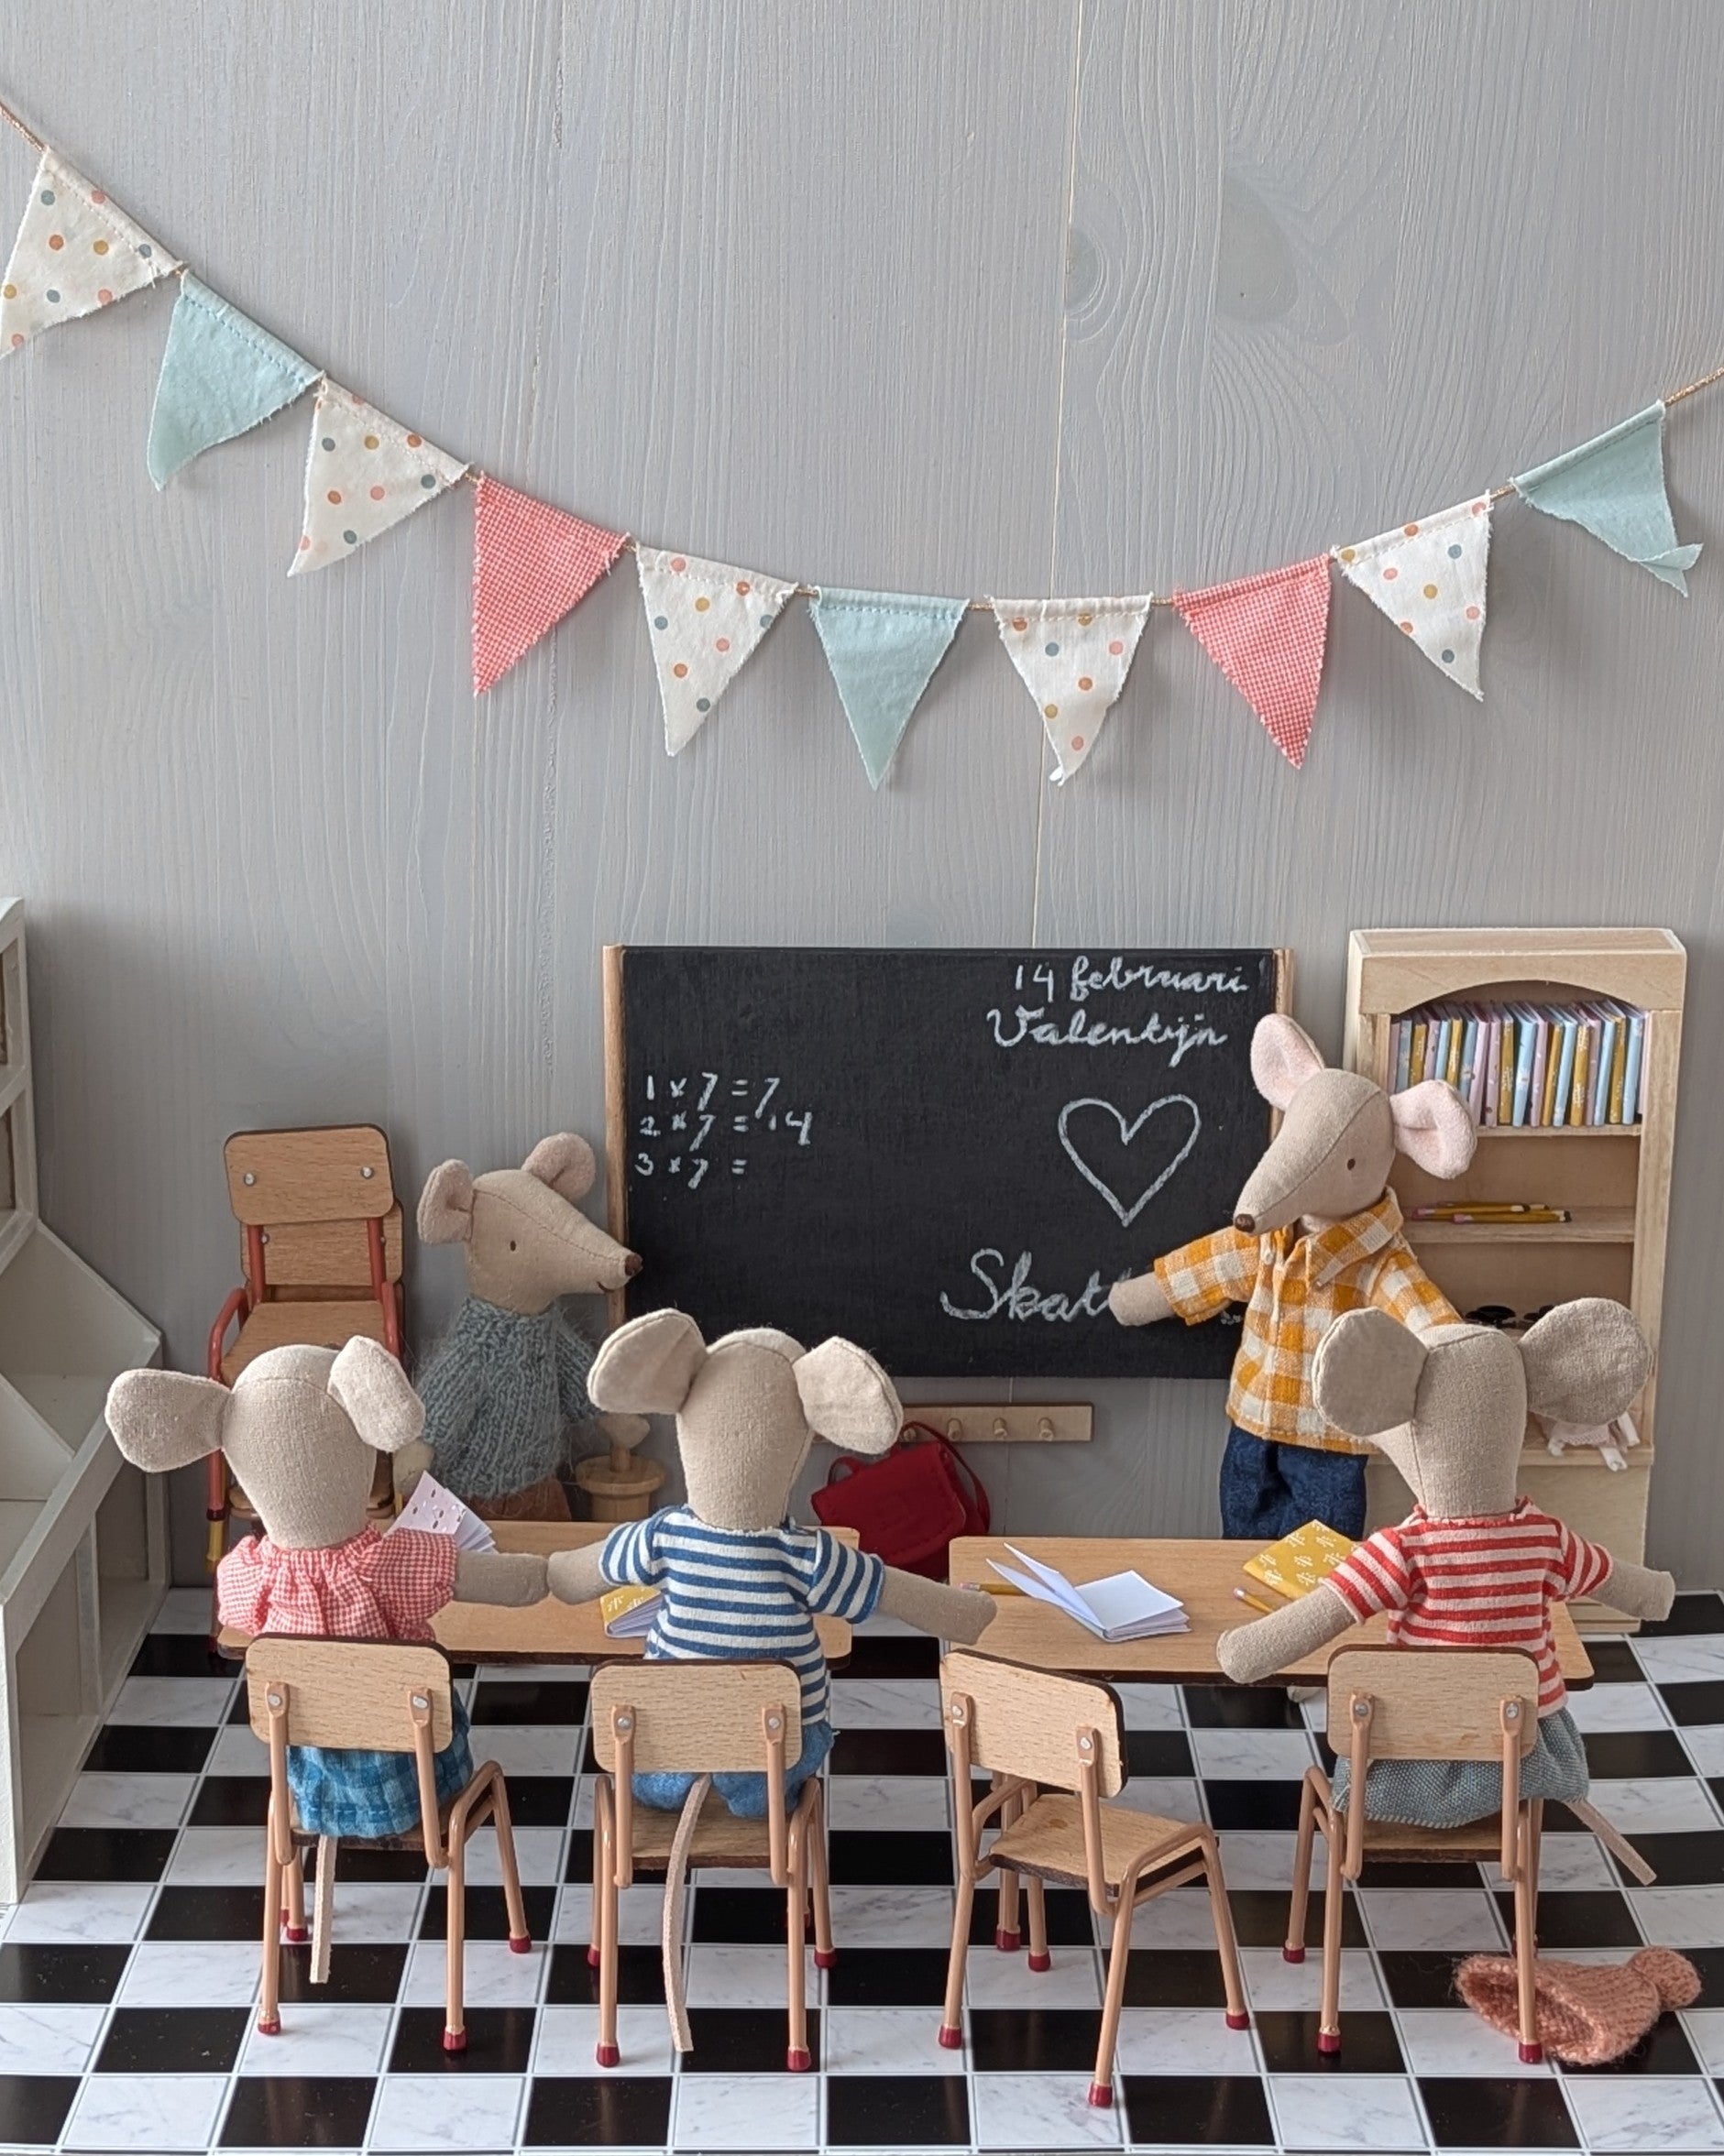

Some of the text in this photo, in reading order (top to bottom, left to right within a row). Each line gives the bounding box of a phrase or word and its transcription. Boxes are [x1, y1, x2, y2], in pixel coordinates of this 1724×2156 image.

[1014, 955, 1249, 1002] 14 februari
[986, 1004, 1228, 1067] Valentijn
[646, 1075, 655, 1100] 1
[697, 1071, 719, 1111] 7
[731, 1078, 749, 1096] =
[754, 1077, 780, 1119] 7
[640, 1116, 662, 1136] 2
[688, 1114, 717, 1152] 7
[732, 1115, 749, 1132] =
[768, 1111, 813, 1145] 14
[634, 1153, 654, 1176] 3
[687, 1158, 708, 1189] 7
[731, 1159, 748, 1175] =
[939, 1248, 1133, 1322] Skat
